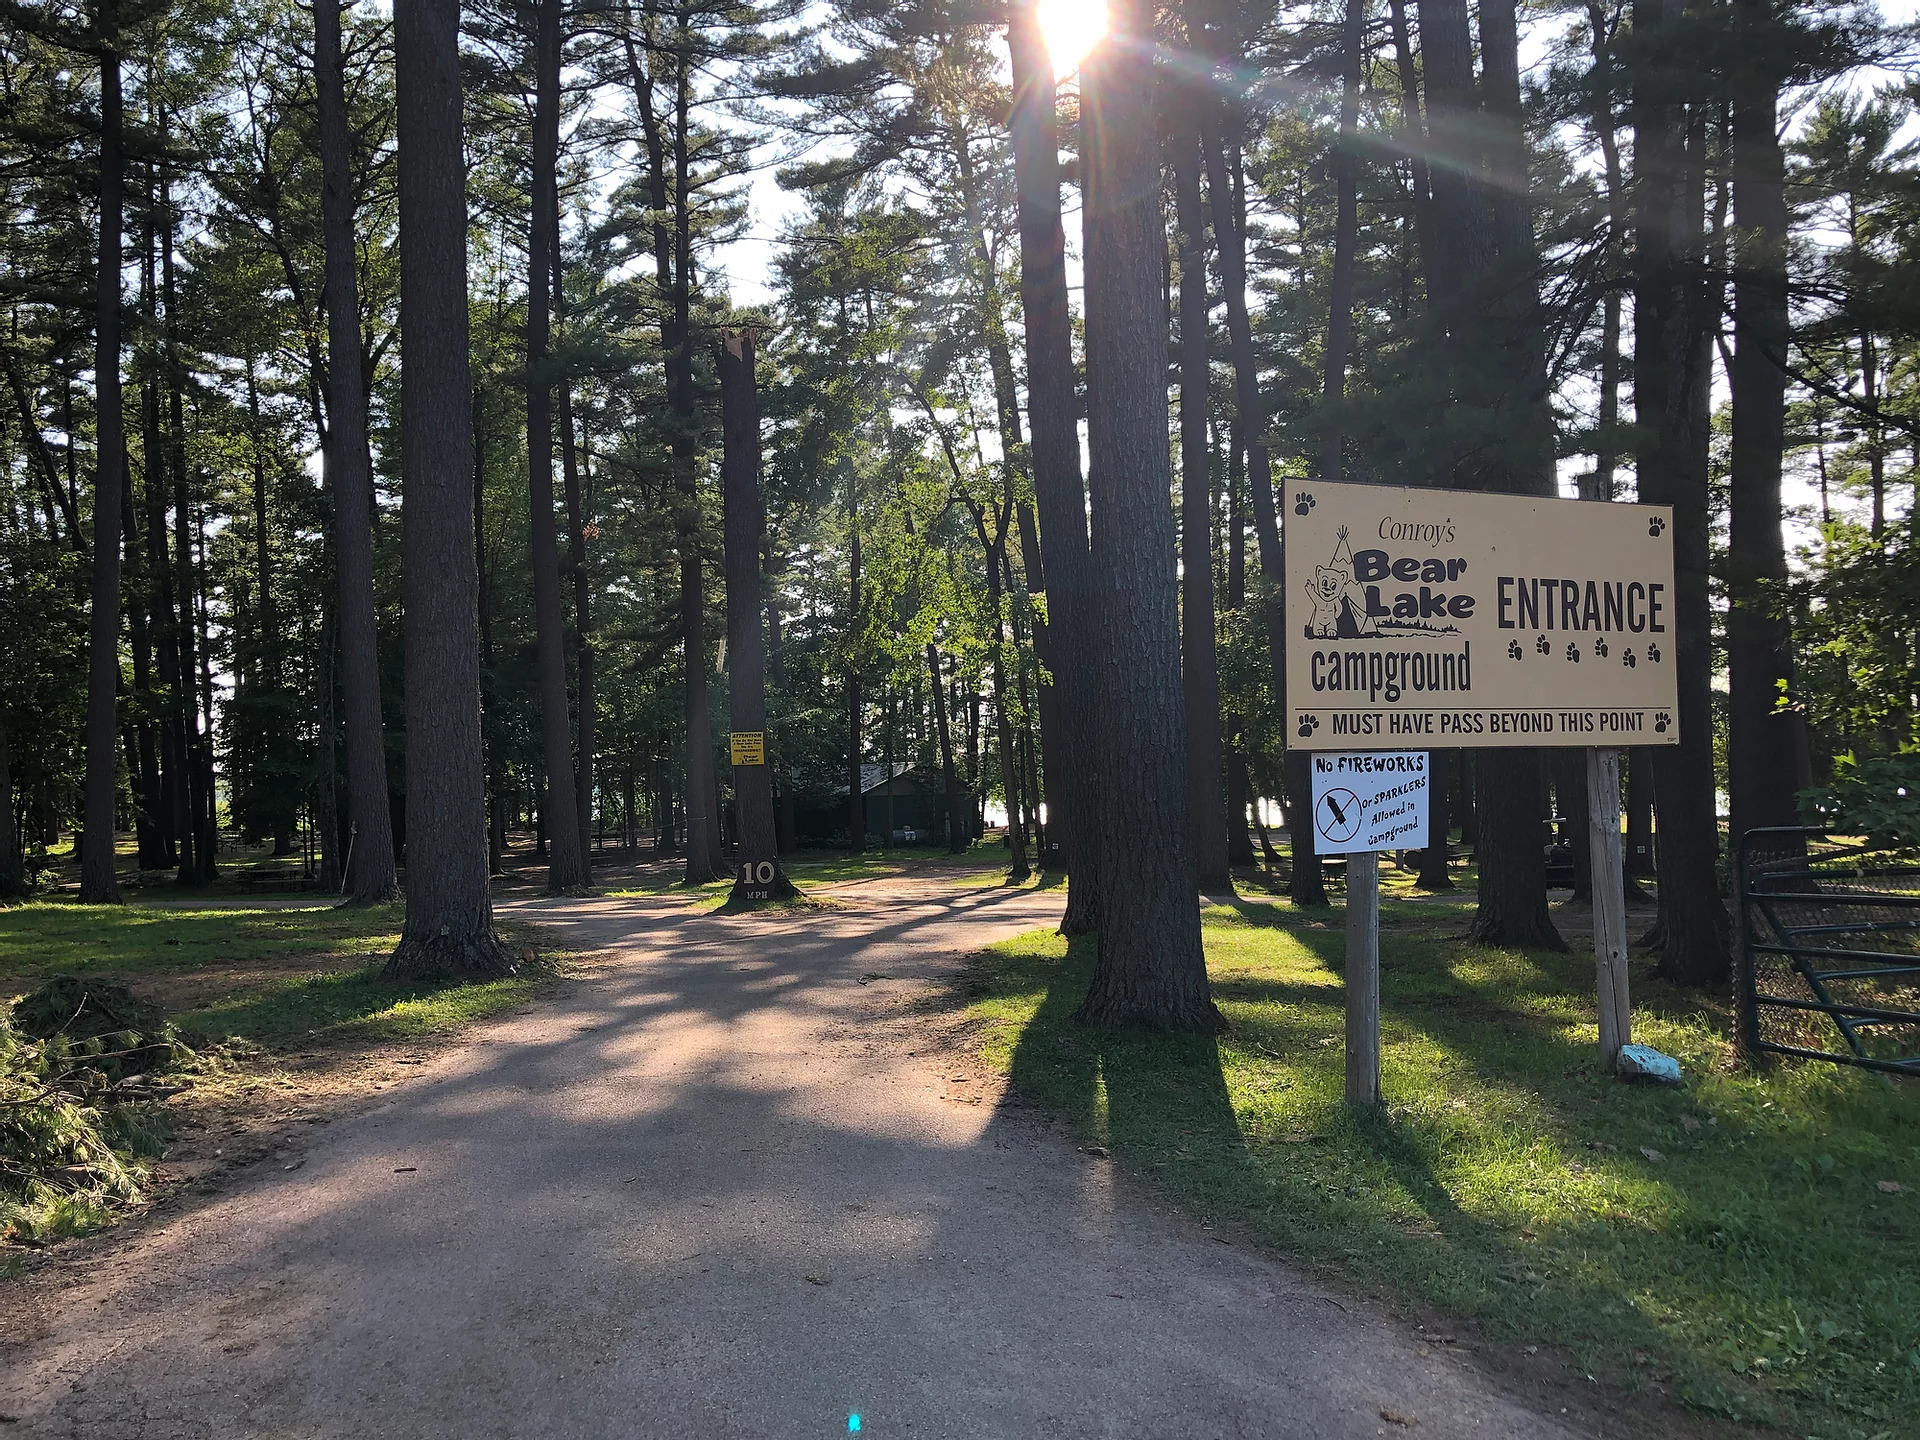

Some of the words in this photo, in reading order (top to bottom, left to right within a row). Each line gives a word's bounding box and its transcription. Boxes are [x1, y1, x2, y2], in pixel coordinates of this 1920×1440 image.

[1378, 516, 1456, 548] Conroy's
[1353, 549, 1468, 583] Bear
[1366, 585, 1476, 618] Lake
[1497, 576, 1665, 633] ENTRANCE
[1311, 640, 1471, 702] campground
[1332, 713, 1383, 735] MUST
[1389, 713, 1434, 734] HAVE
[1440, 713, 1484, 734] PASS
[1490, 712, 1553, 733] BEYOND
[1558, 712, 1594, 732] THIS
[1600, 711, 1644, 732] POINT
[1316, 757, 1333, 773] No
[1337, 755, 1424, 773] FIREWORKS
[1375, 776, 1426, 804] SPARKLERS
[1371, 801, 1405, 826] Allowed
[1407, 802, 1415, 811] in
[743, 861, 775, 884] 10
[746, 891, 768, 899] MPH
